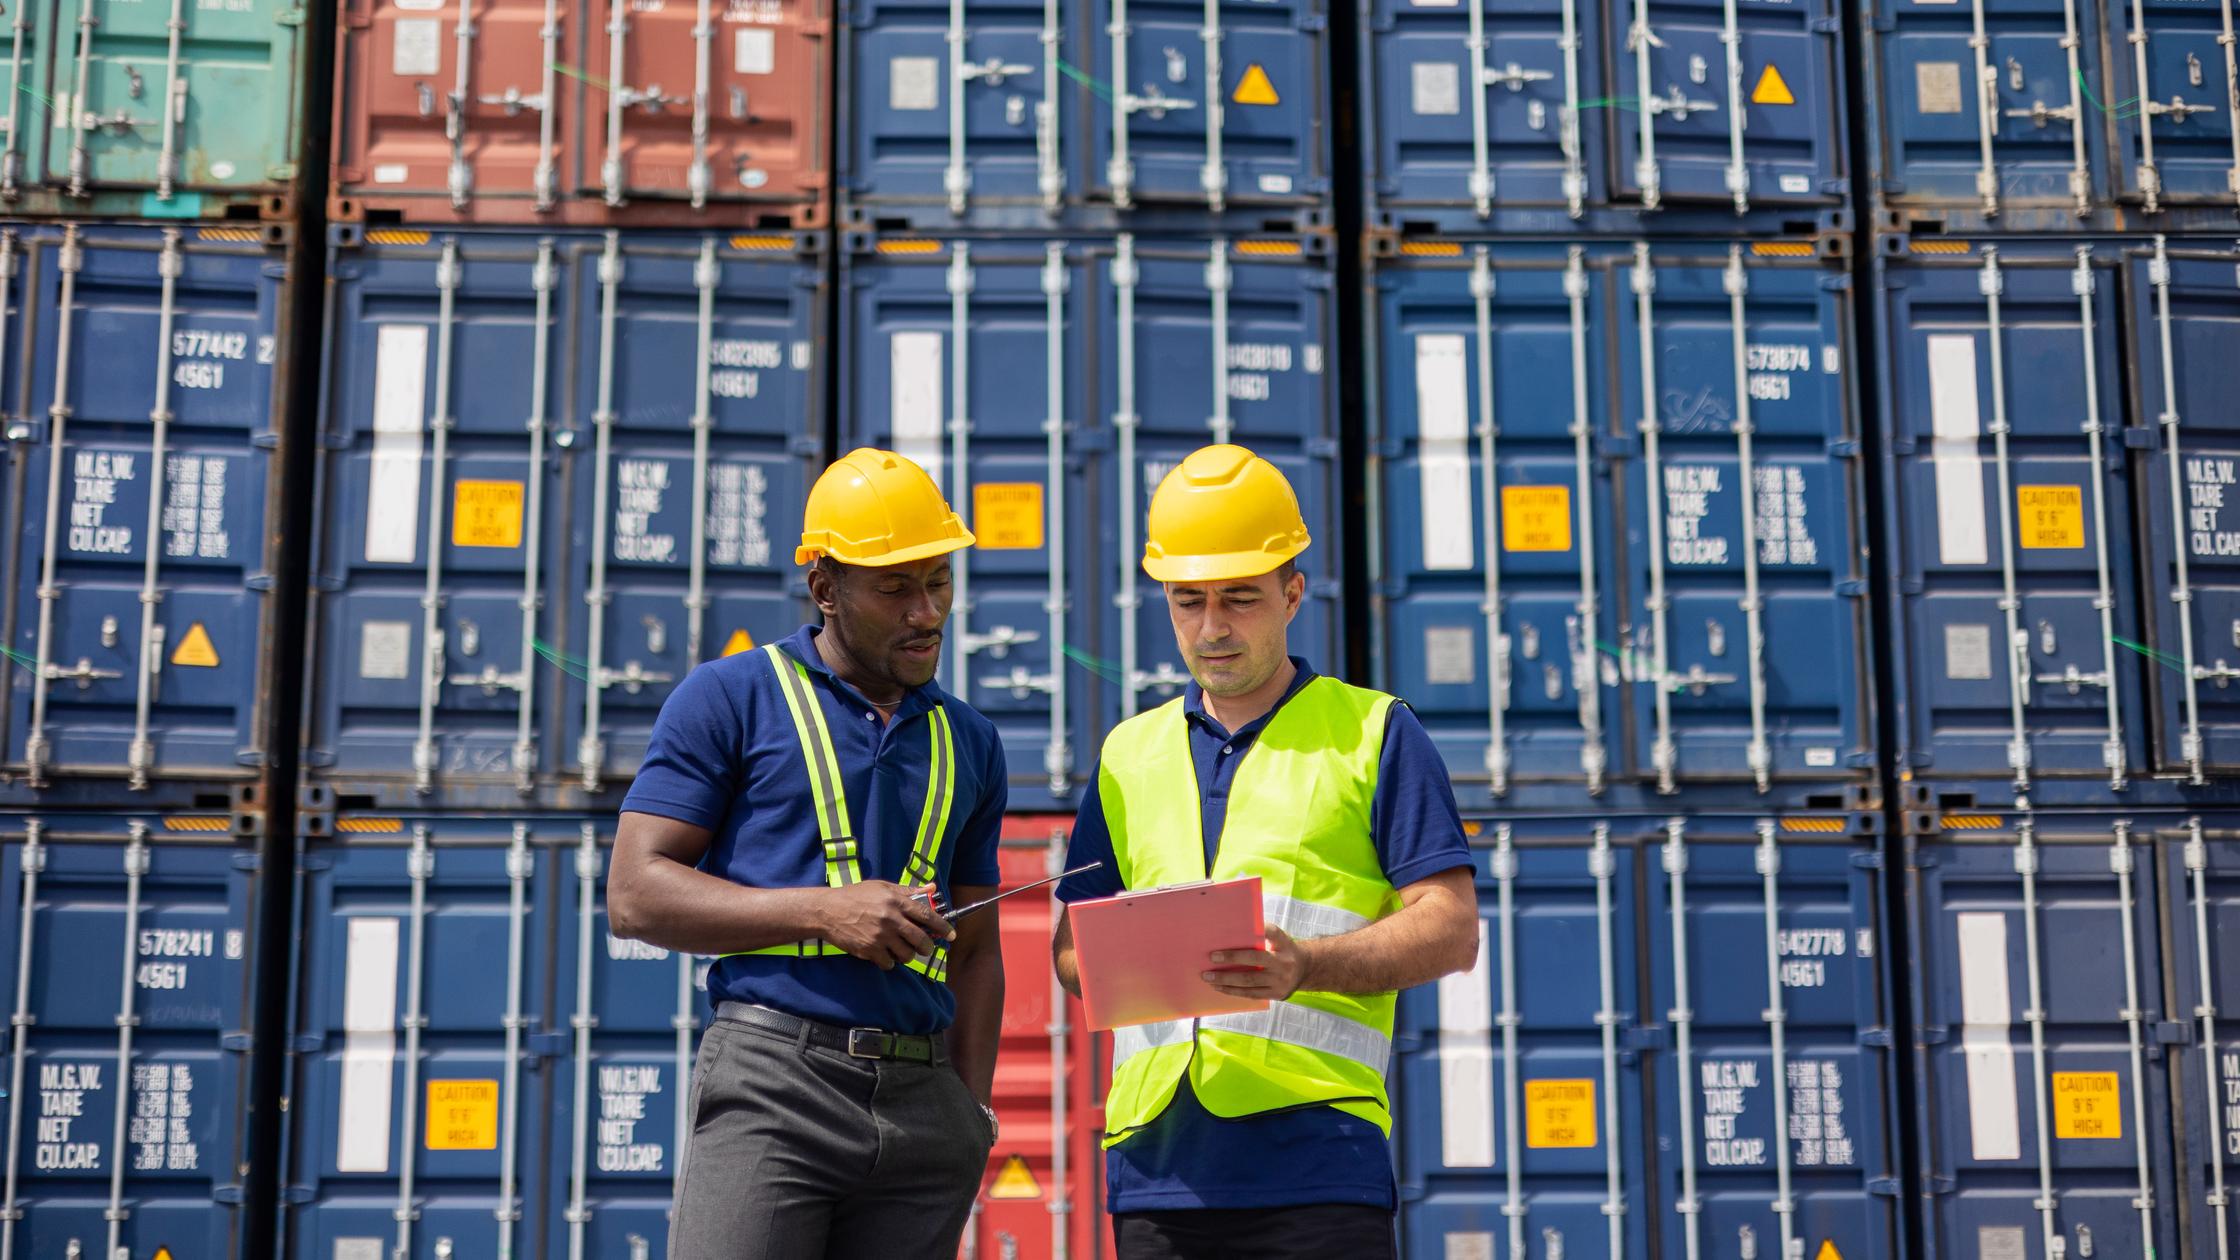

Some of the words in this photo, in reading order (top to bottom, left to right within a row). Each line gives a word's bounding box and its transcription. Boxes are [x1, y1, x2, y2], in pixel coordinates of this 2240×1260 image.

[172, 329, 247, 359] 577442
[2023, 491, 2077, 506] CAUTION
[2189, 483, 2224, 508] TARE
[2190, 508, 2218, 532] NET
[138, 928, 213, 957] 578241
[225, 928, 243, 959] 8
[39, 1063, 102, 1090] M.G.W.
[2059, 1077, 2112, 1092] CAUTION
[40, 1090, 83, 1116] TARE
[37, 1116, 72, 1142] NET
[598, 1119, 636, 1145] NET
[2074, 1119, 2103, 1134] HIGH
[36, 1143, 100, 1170] CU.CAP.
